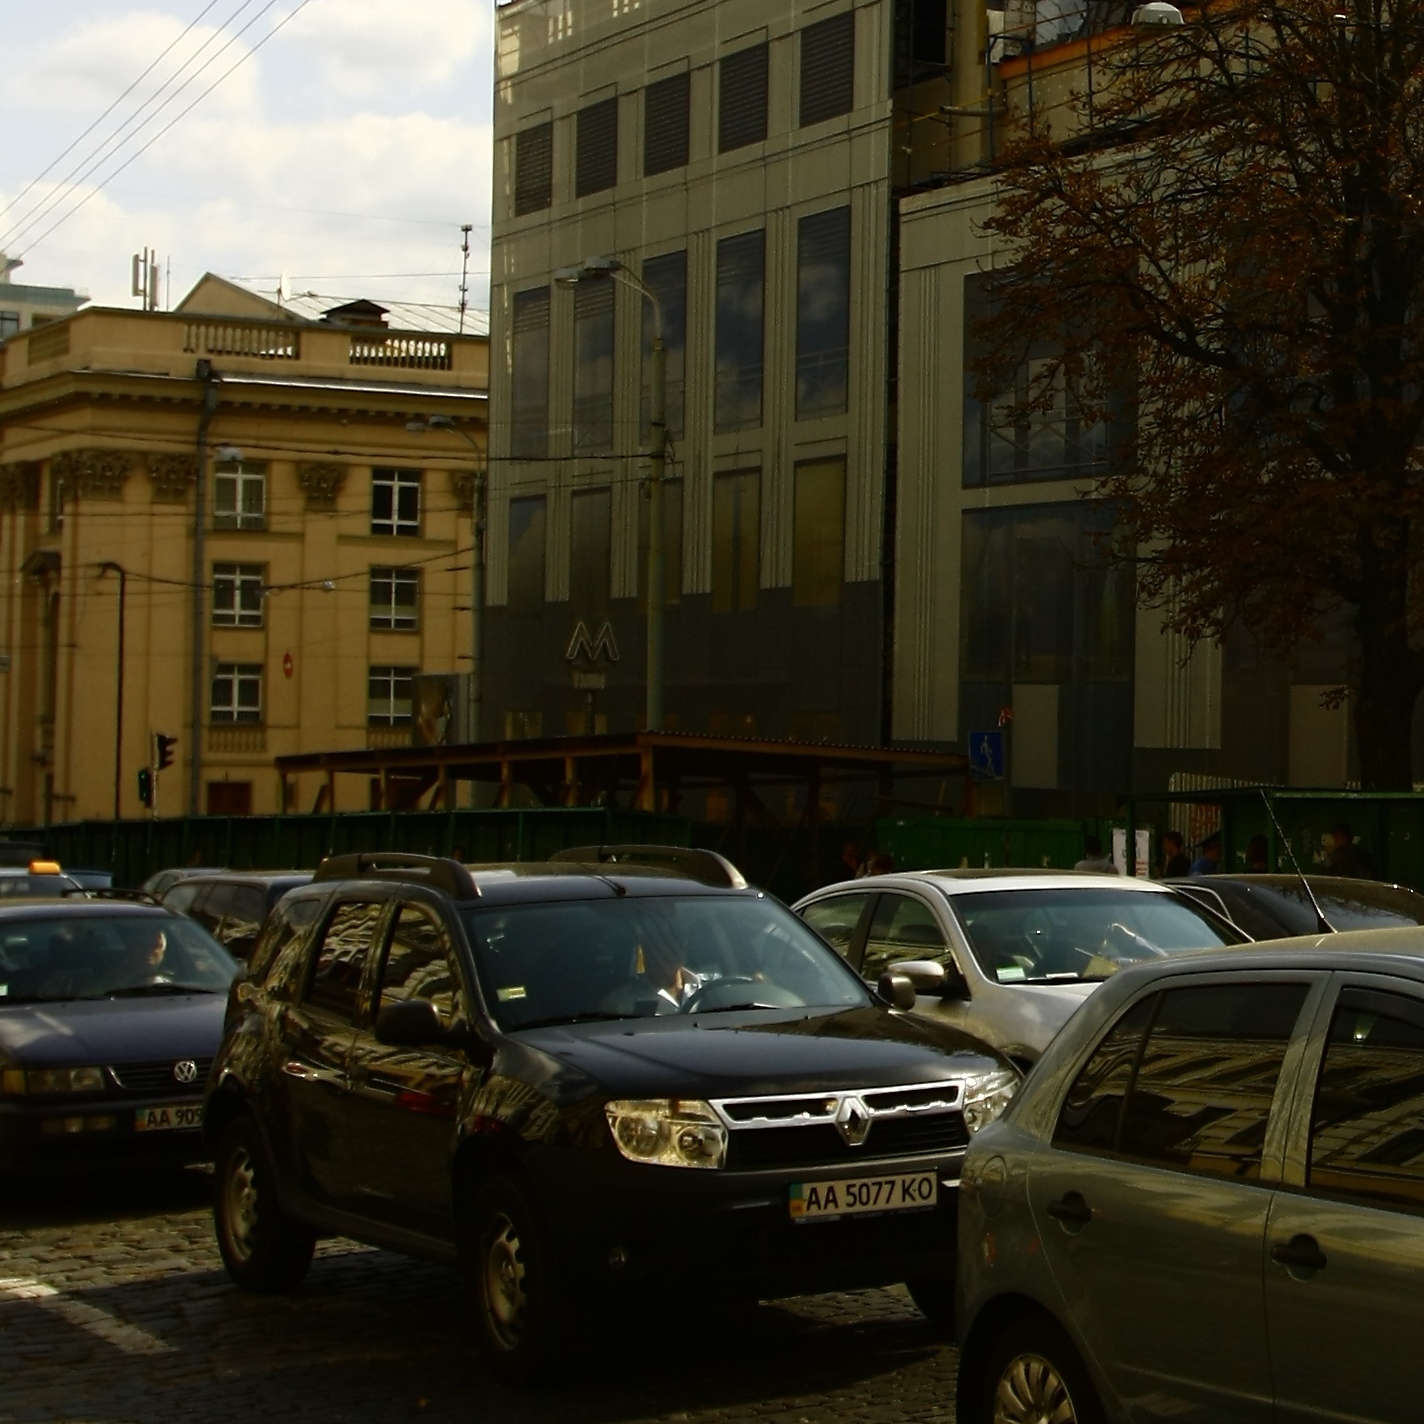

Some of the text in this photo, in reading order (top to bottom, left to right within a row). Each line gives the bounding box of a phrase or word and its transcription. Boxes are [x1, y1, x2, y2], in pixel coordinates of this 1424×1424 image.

[147, 1110, 170, 1127] AA
[806, 1185, 839, 1211] AA
[846, 1180, 896, 1208] 5077
[902, 1177, 933, 1203] KO
